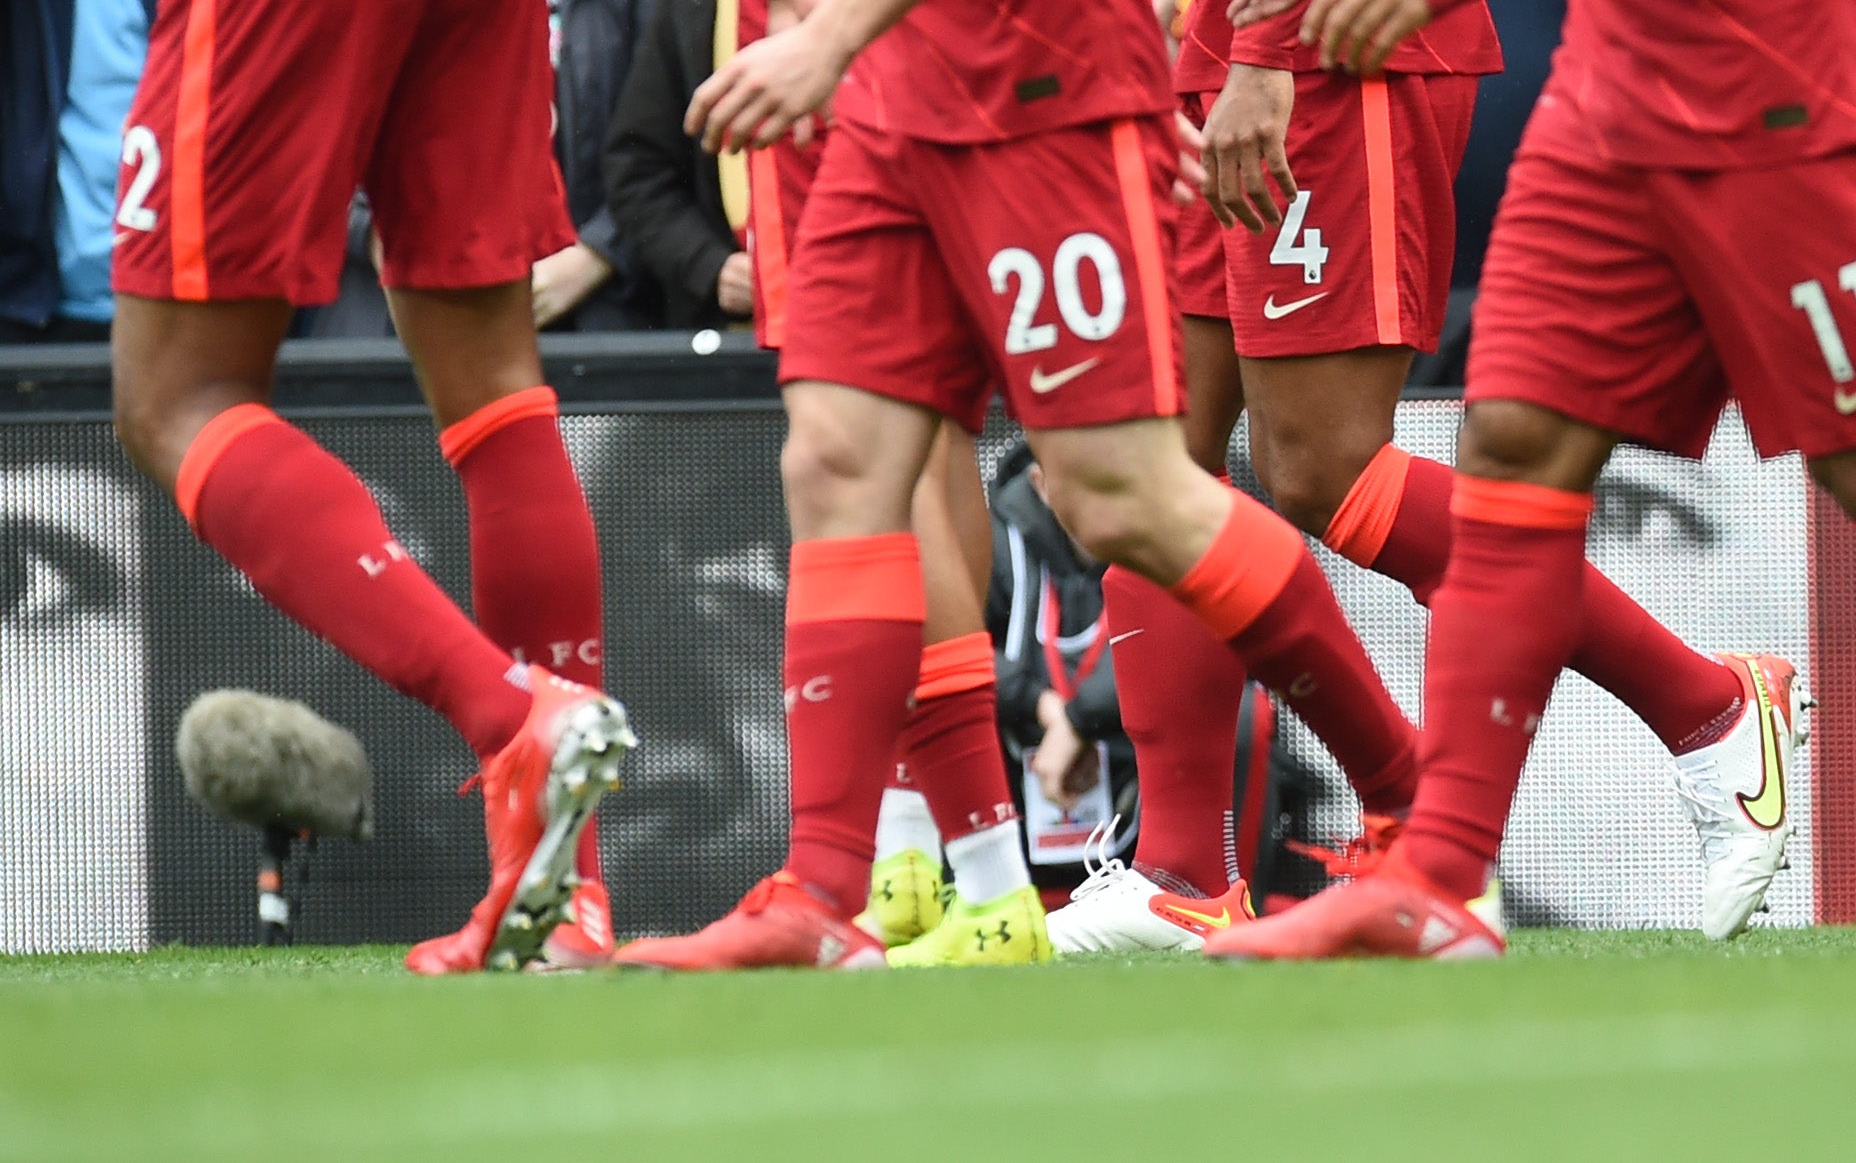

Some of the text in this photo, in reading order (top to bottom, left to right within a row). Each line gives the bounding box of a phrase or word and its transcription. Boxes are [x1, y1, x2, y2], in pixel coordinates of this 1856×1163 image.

[116, 125, 162, 232] 2
[1269, 190, 1329, 284] 4
[987, 232, 1127, 355] 20
